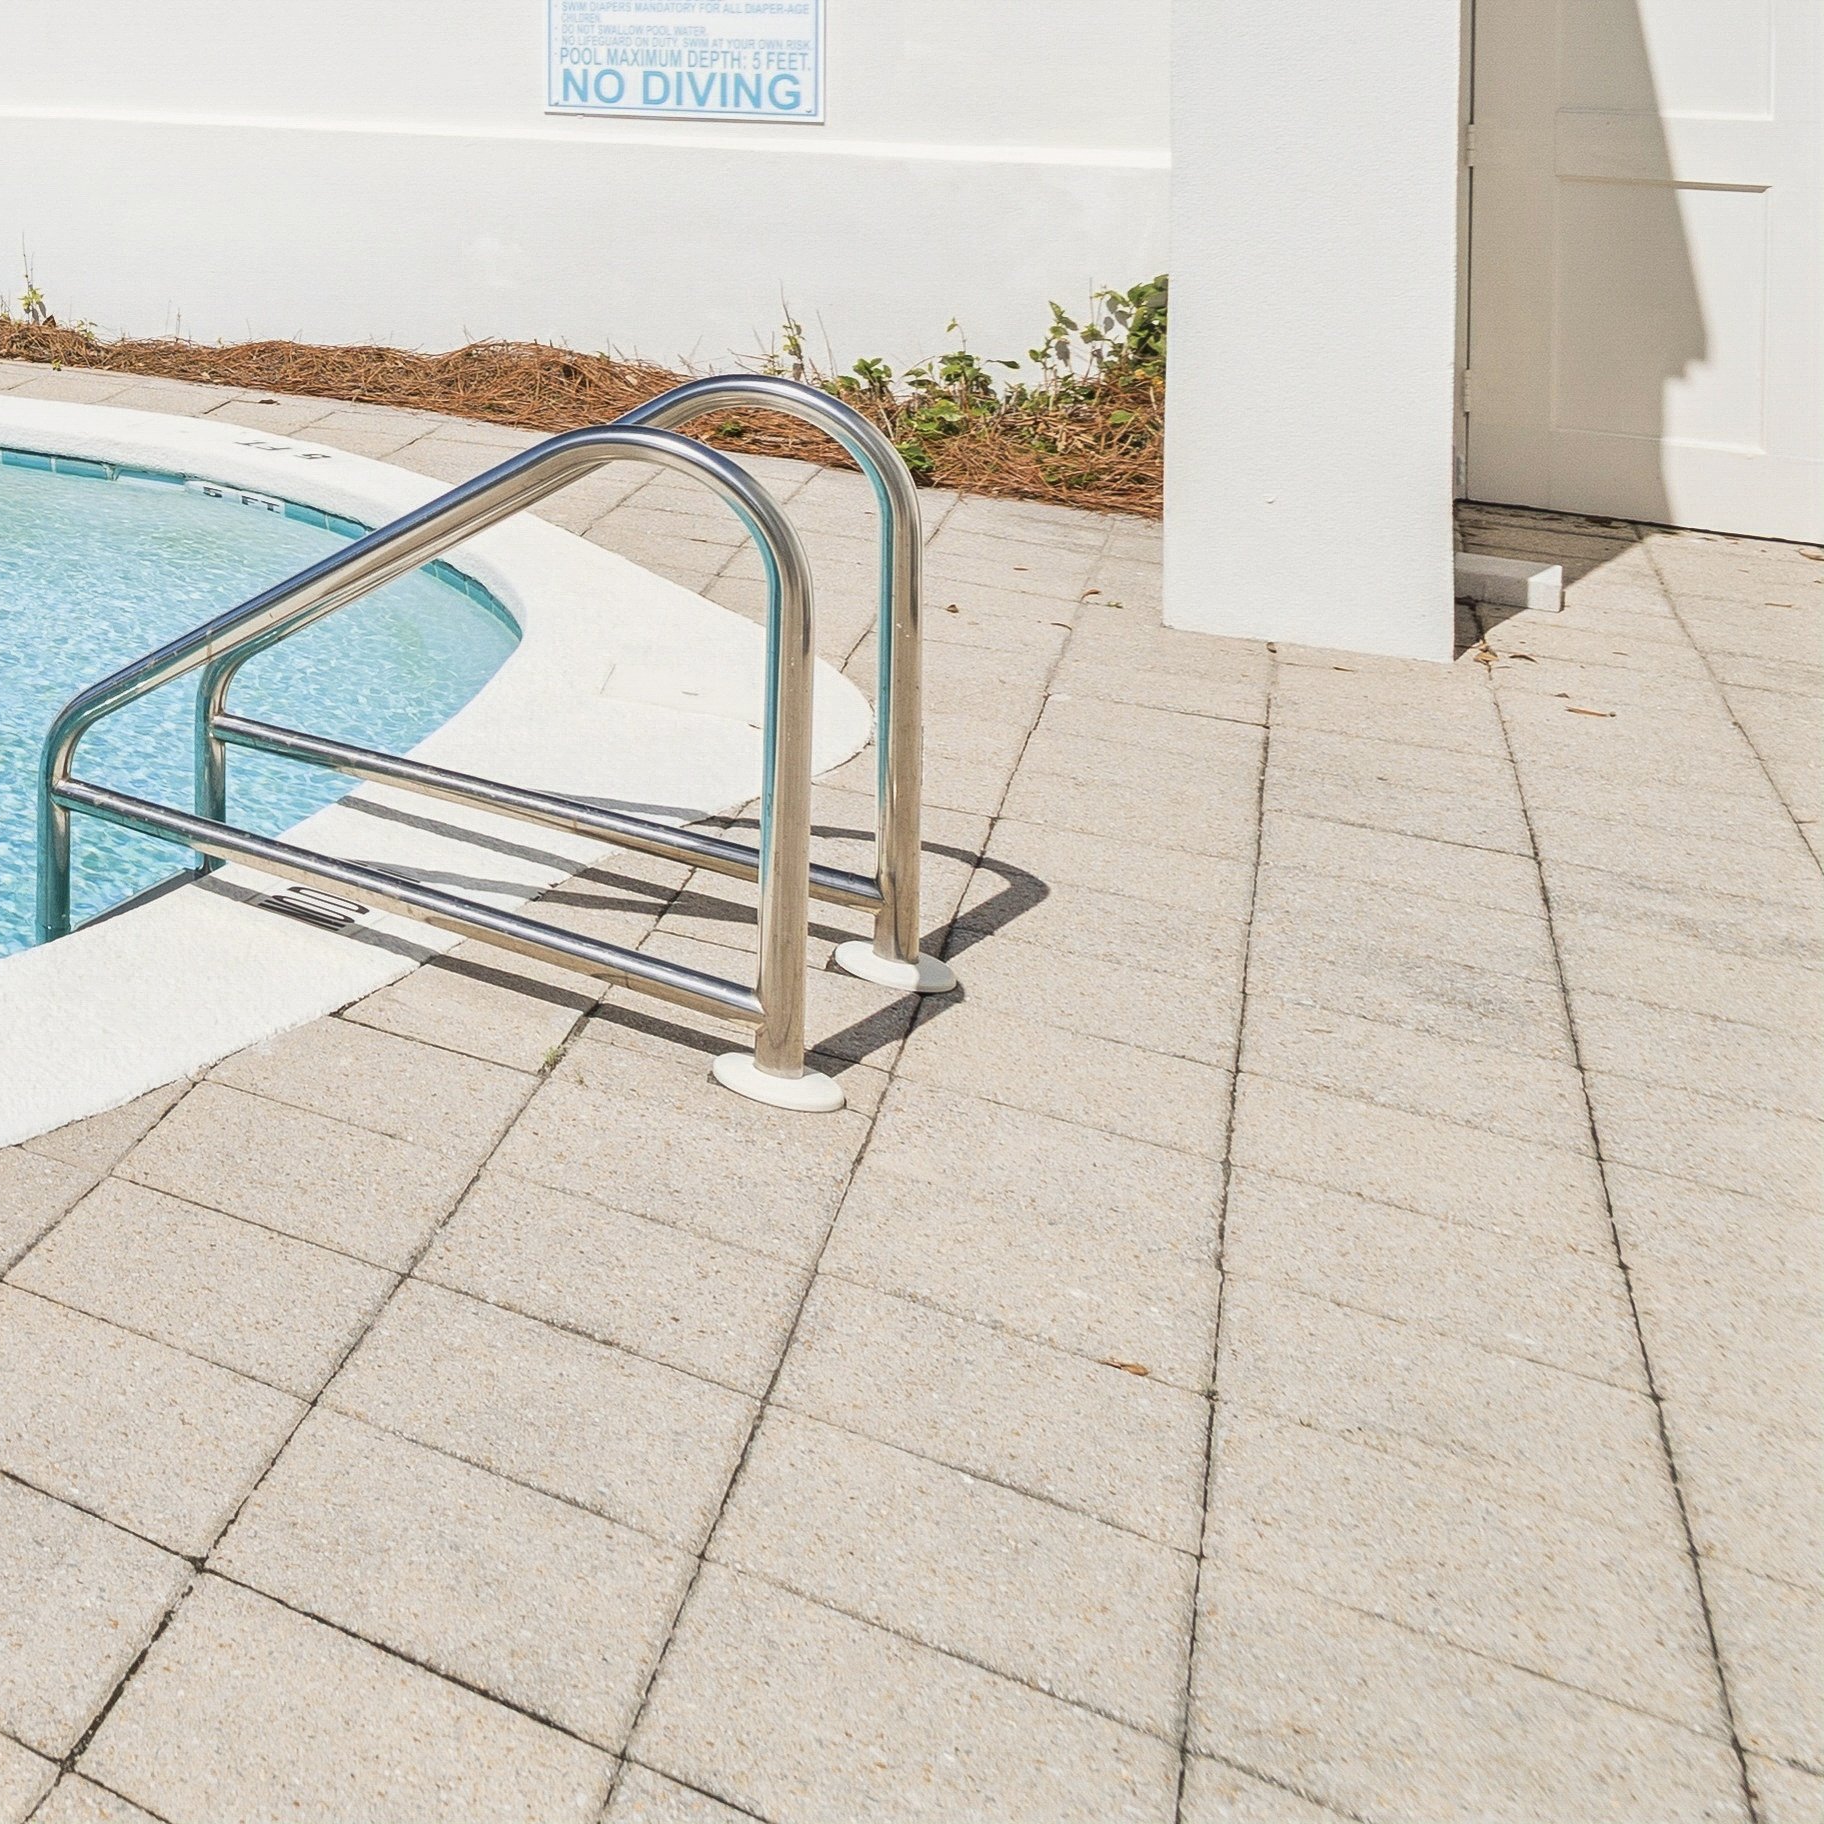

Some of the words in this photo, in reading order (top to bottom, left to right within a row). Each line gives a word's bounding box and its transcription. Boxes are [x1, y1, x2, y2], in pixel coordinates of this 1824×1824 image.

[561, 1, 587, 12] SWIM
[589, 1, 631, 12] DIAPERS
[634, 1, 696, 13] MANDATORY
[699, 2, 720, 14] FOR
[722, 2, 742, 14] ALL
[597, 24, 644, 35] SWALLOW
[645, 24, 672, 36] POOL
[561, 34, 575, 45] NO
[577, 34, 632, 47] LIFEGUARD
[634, 36, 649, 47] ON
[681, 36, 709, 48] SWIM
[711, 37, 723, 49] AT
[725, 37, 755, 49] YOUR
[758, 38, 783, 50] OWN
[559, 46, 602, 65] POOL
[606, 47, 682, 67] MAXIMUM
[687, 49, 746, 69] DEPTH:
[752, 50, 761, 69] 5
[766, 51, 811, 71] FEET.
[562, 67, 625, 104] NO
[642, 69, 801, 111] DIVING
